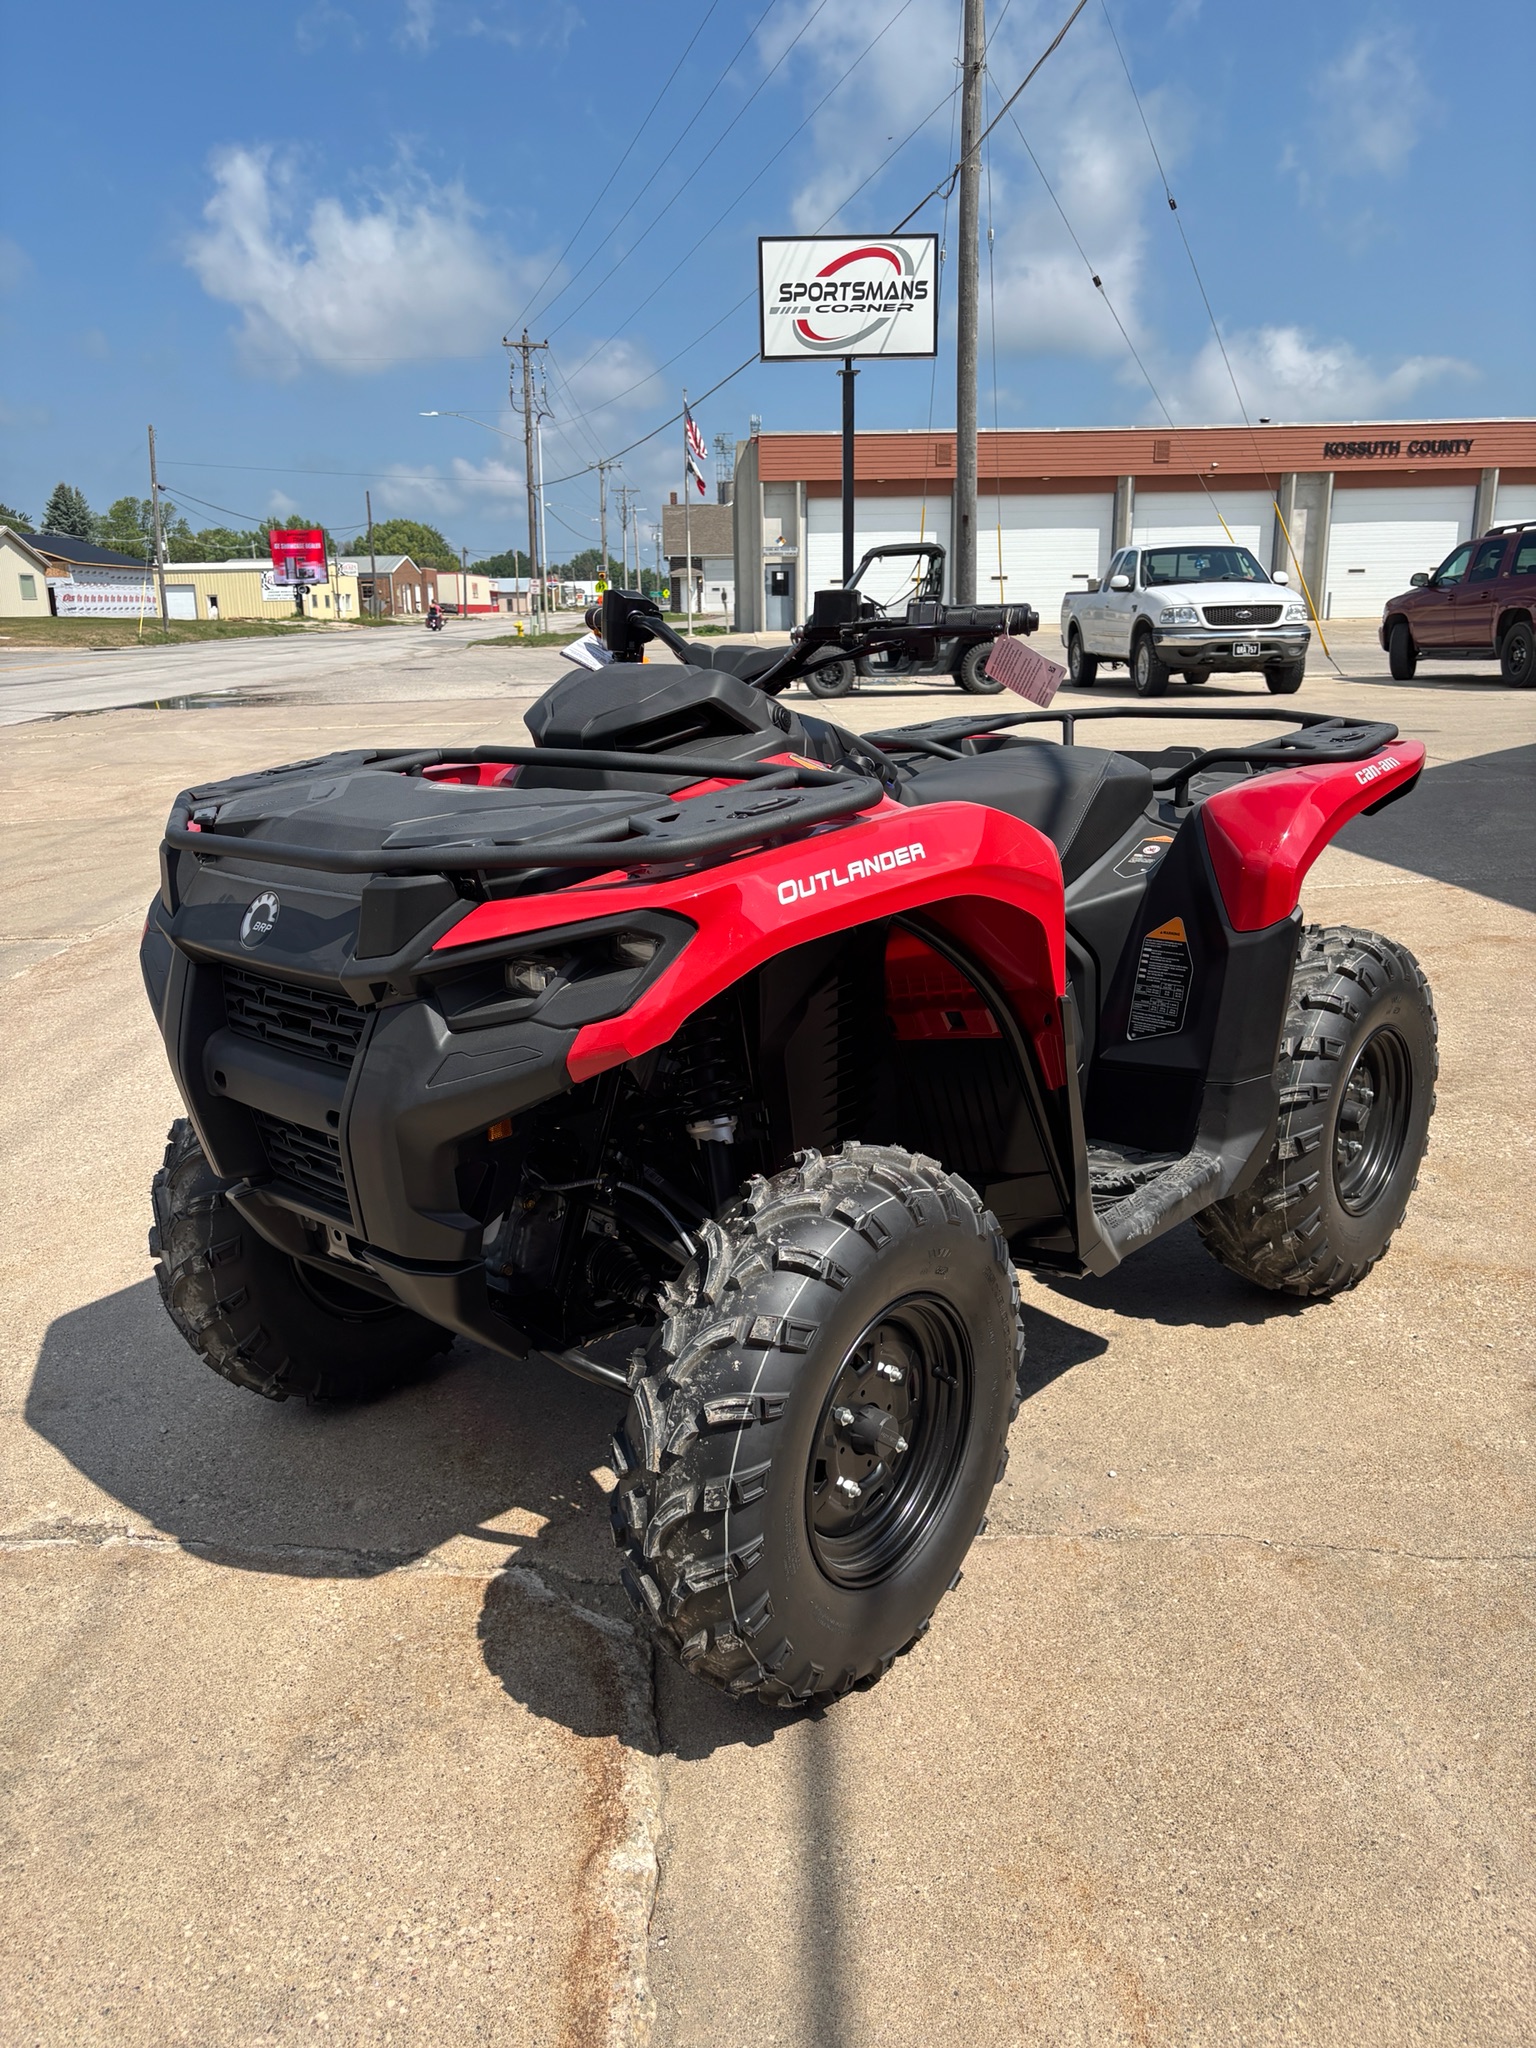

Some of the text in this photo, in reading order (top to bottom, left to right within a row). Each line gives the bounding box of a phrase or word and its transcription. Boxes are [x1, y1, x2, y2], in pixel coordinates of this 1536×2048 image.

[779, 280, 929, 302] SPORTSMANS
[815, 303, 914, 313] CORNER
[1324, 439, 1475, 457] KOSSUTH COUNTY
[1354, 756, 1401, 785] can-am
[777, 842, 926, 905] OUTLANDER
[252, 921, 273, 933] BRP
